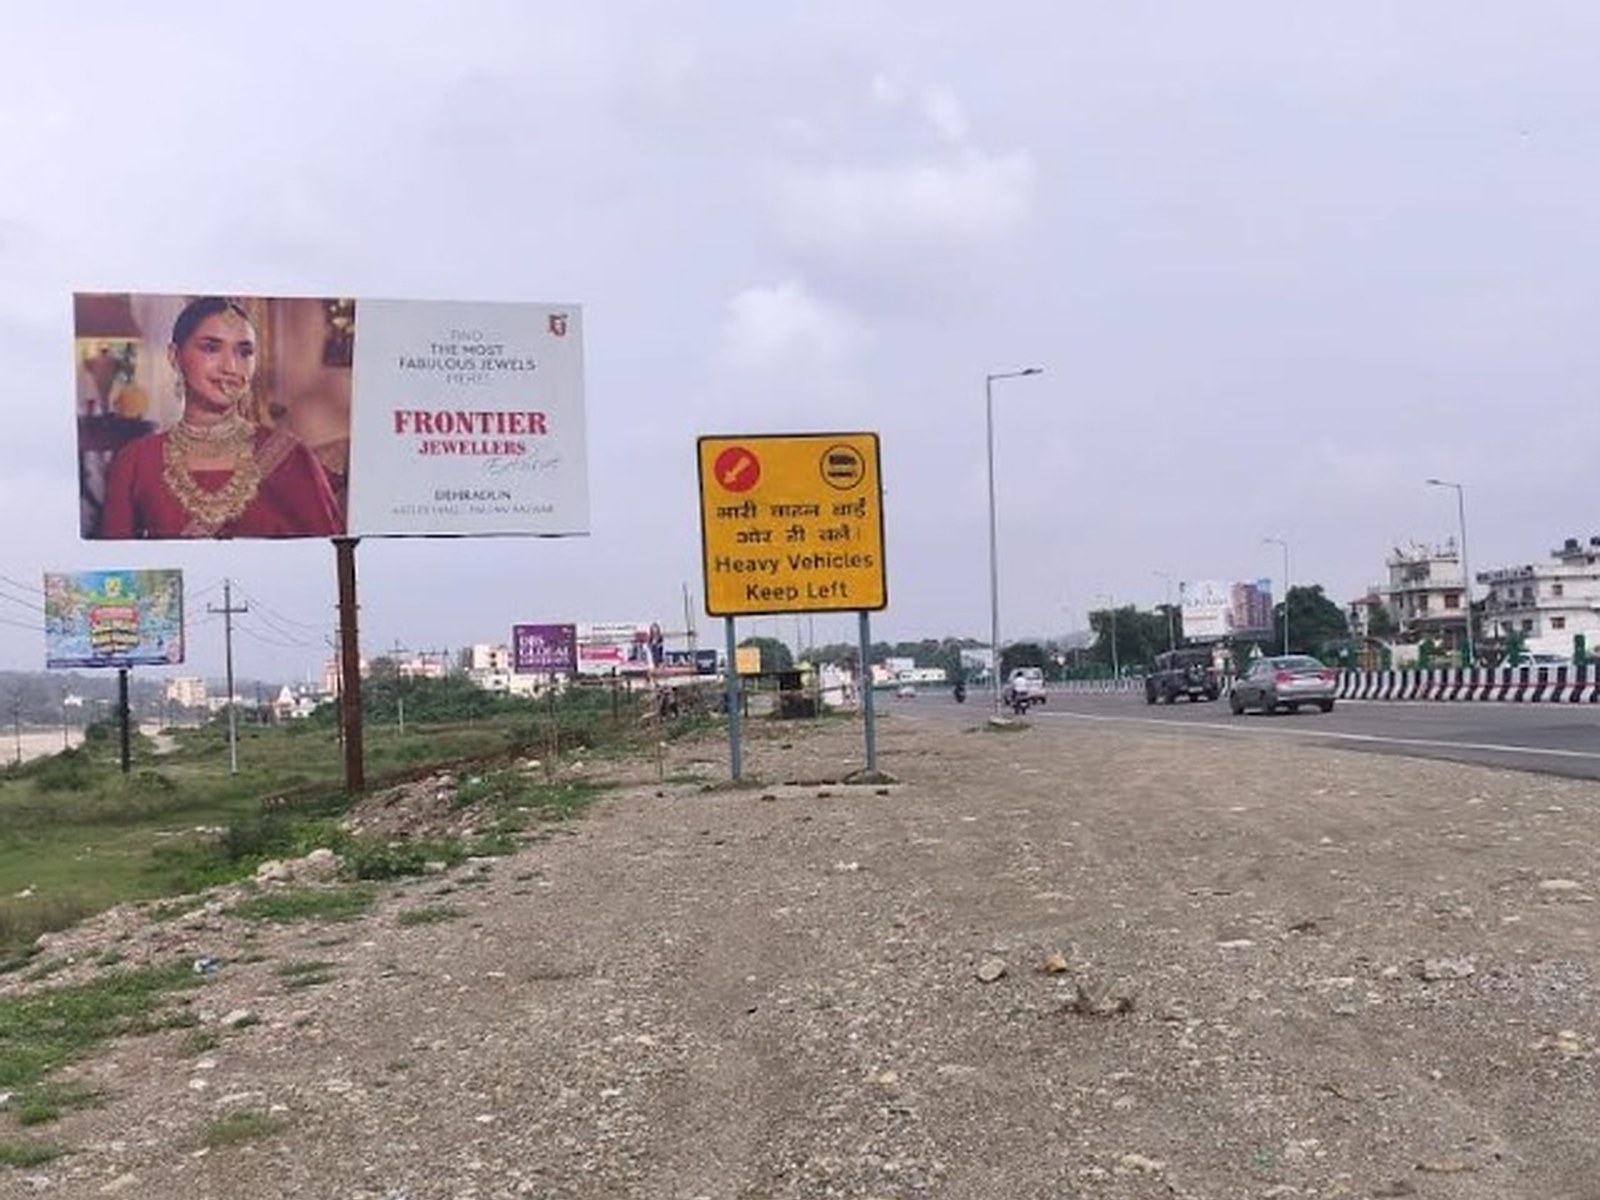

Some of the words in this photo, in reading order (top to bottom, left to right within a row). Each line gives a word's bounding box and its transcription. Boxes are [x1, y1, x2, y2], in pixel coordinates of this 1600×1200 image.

[431, 343, 458, 356] THE
[462, 344, 504, 356] MOST
[399, 356, 476, 371] FABULOUS
[480, 358, 536, 371] JEWELS
[394, 410, 548, 435] FRONTIER
[419, 440, 527, 455] JEWELLERS
[434, 489, 512, 501] DEHRADUN
[715, 555, 780, 575] Heavy
[787, 553, 874, 571] Vehicles
[746, 583, 799, 602] Keep
[807, 581, 849, 599] Left
